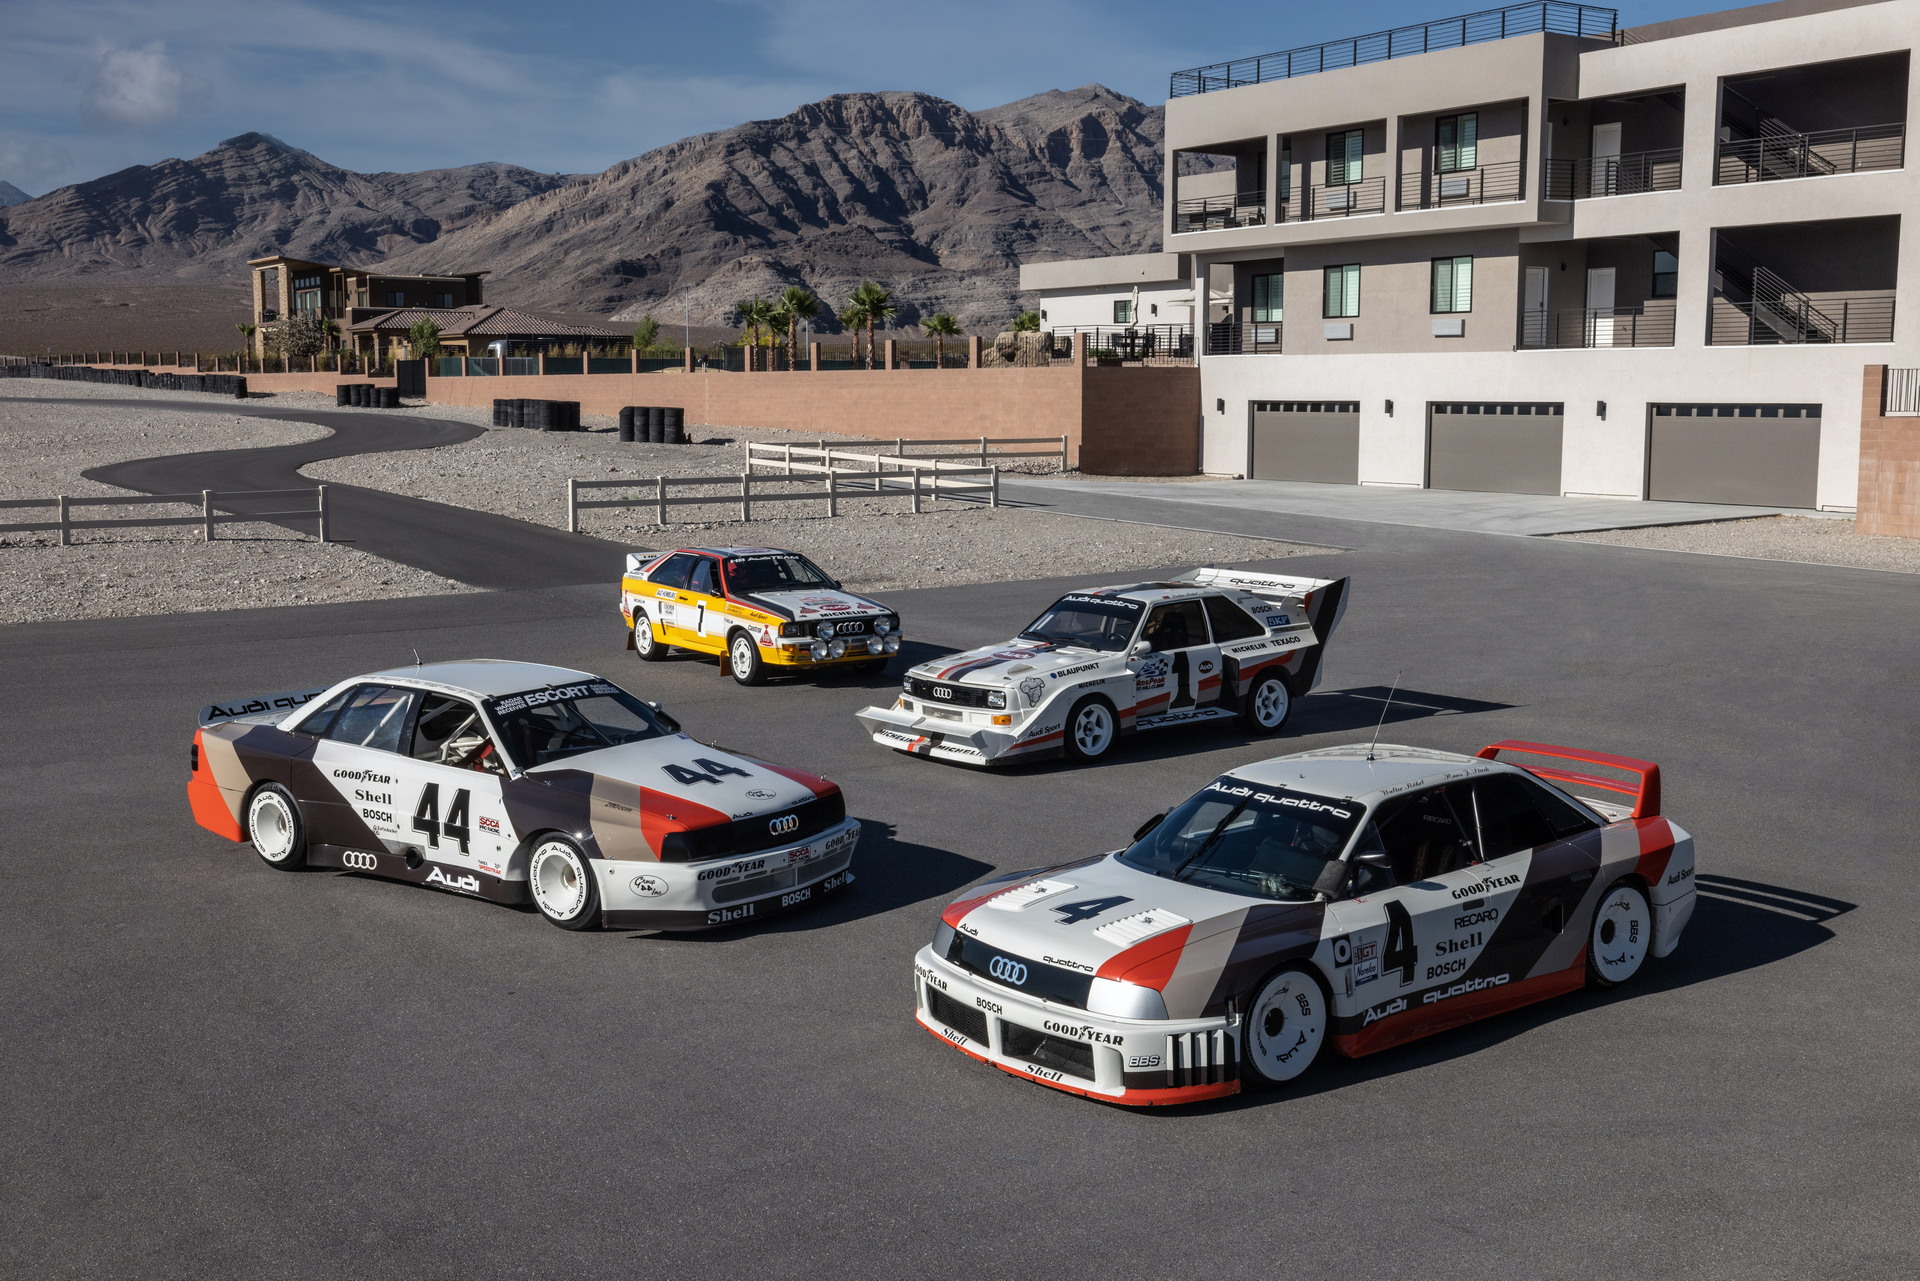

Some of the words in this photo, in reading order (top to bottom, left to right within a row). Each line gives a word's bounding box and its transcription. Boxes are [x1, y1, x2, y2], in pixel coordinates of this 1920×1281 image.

[1230, 578, 1296, 589] quattro
[1090, 598, 1138, 610] quattro
[1251, 605, 1272, 614] BOSCH
[698, 604, 704, 632] 7
[820, 610, 868, 618] MICHELIN
[1268, 616, 1288, 626] SKF
[748, 624, 762, 633] Castrol
[1232, 642, 1266, 653] MICHELIN
[1272, 636, 1300, 647] TEXACO
[1057, 662, 1100, 677] BLAUPUNKT
[1078, 679, 1106, 689] MICHELIN
[1168, 651, 1196, 710] 1
[500, 696, 523, 706] RADAR
[524, 686, 589, 706] ESCORT
[208, 700, 271, 720] Audi
[494, 700, 525, 711] WARNING
[498, 704, 527, 715] RECEIVER
[1136, 710, 1219, 726] quattro
[879, 729, 916, 743] MICHELIN
[1028, 728, 1044, 738] Audi
[1044, 724, 1061, 734] Sport
[661, 758, 754, 786] 44
[257, 794, 274, 805] Audi
[355, 789, 392, 805] Shell
[791, 795, 817, 805] quattro
[1204, 782, 1253, 797] Audi
[1253, 792, 1351, 819] quattro
[277, 800, 292, 845] quattro
[363, 808, 392, 823] BOSCH
[411, 782, 470, 856] 44
[480, 817, 500, 829] SCCA
[1423, 814, 1452, 824] RECARO
[251, 808, 266, 853] quattro
[270, 847, 287, 858] Audi
[551, 845, 573, 860] Audi
[789, 847, 810, 859] SCCA
[425, 866, 480, 892] Audi
[533, 849, 547, 896] quattro
[1668, 872, 1680, 886] Audi
[1680, 867, 1694, 880] Sport
[569, 867, 583, 914] quattro
[708, 903, 755, 924] Shell
[782, 888, 811, 907] BOSCH
[823, 871, 848, 892] Shell
[542, 901, 564, 917] Audi
[1049, 895, 1135, 925] 4
[1454, 908, 1498, 929] RECARO
[1629, 920, 1638, 943] BBS
[959, 923, 979, 937] Audi
[1043, 955, 1094, 972] quattro
[1362, 944, 1376, 958] GT
[1381, 900, 1418, 988] 4
[1435, 932, 1483, 957] Shell
[1357, 963, 1376, 976] Norelco
[1427, 958, 1466, 980] BOSCH
[976, 996, 1003, 1015] BOSCH
[1295, 993, 1311, 1016] BBS
[1362, 998, 1408, 1027] Audi
[1423, 973, 1510, 1003] quattro
[941, 1027, 968, 1046] Shell
[1276, 1030, 1307, 1063] Audi
[1128, 1056, 1160, 1067] BBS
[1025, 1064, 1065, 1082] Shell
